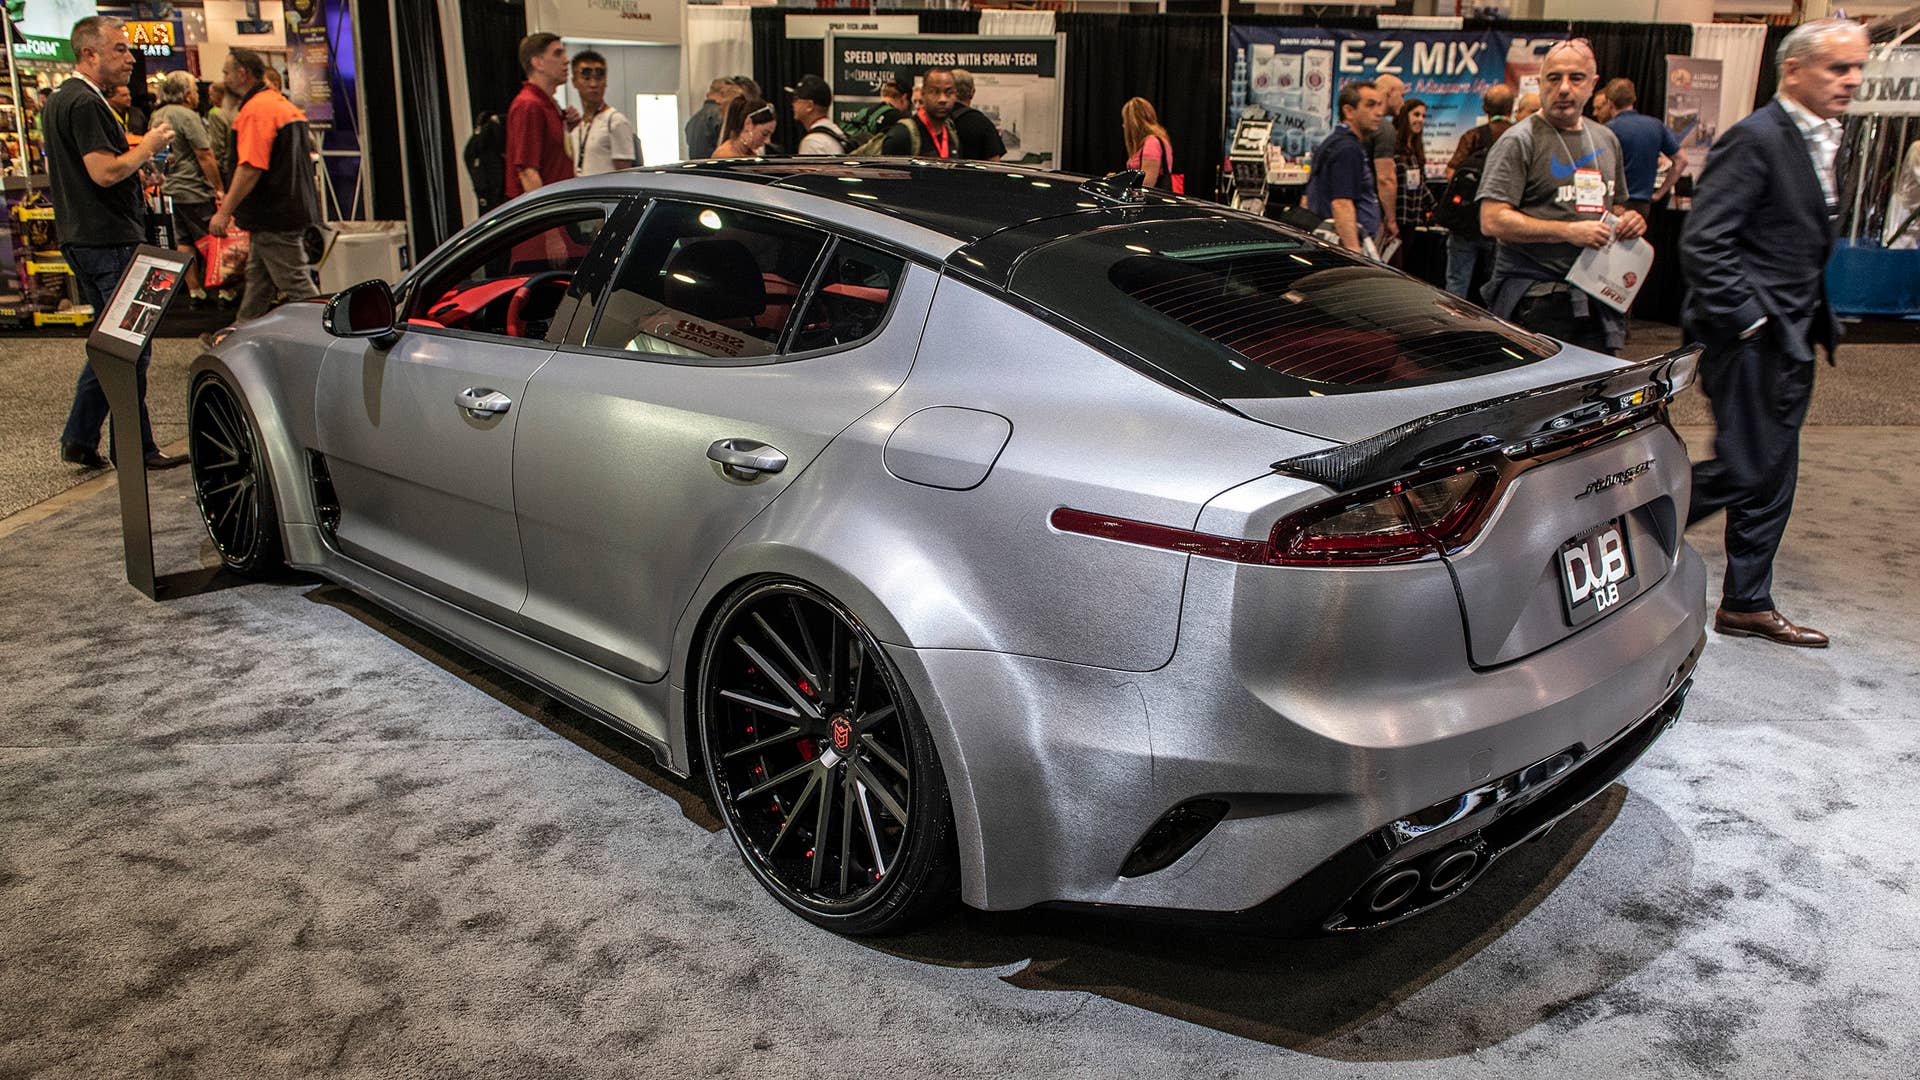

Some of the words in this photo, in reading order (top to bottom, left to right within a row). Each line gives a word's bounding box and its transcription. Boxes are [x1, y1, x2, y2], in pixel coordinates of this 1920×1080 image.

[843, 51, 873, 63] SPEED
[875, 51, 888, 64] UP
[889, 51, 913, 65] YOUR
[914, 52, 956, 66] PROCESS
[957, 53, 980, 66] WITH
[1339, 39, 1404, 73] E-Z
[1284, 115, 1305, 130] MIX
[1563, 528, 1627, 604] DUB
[1594, 582, 1621, 612] DUB
